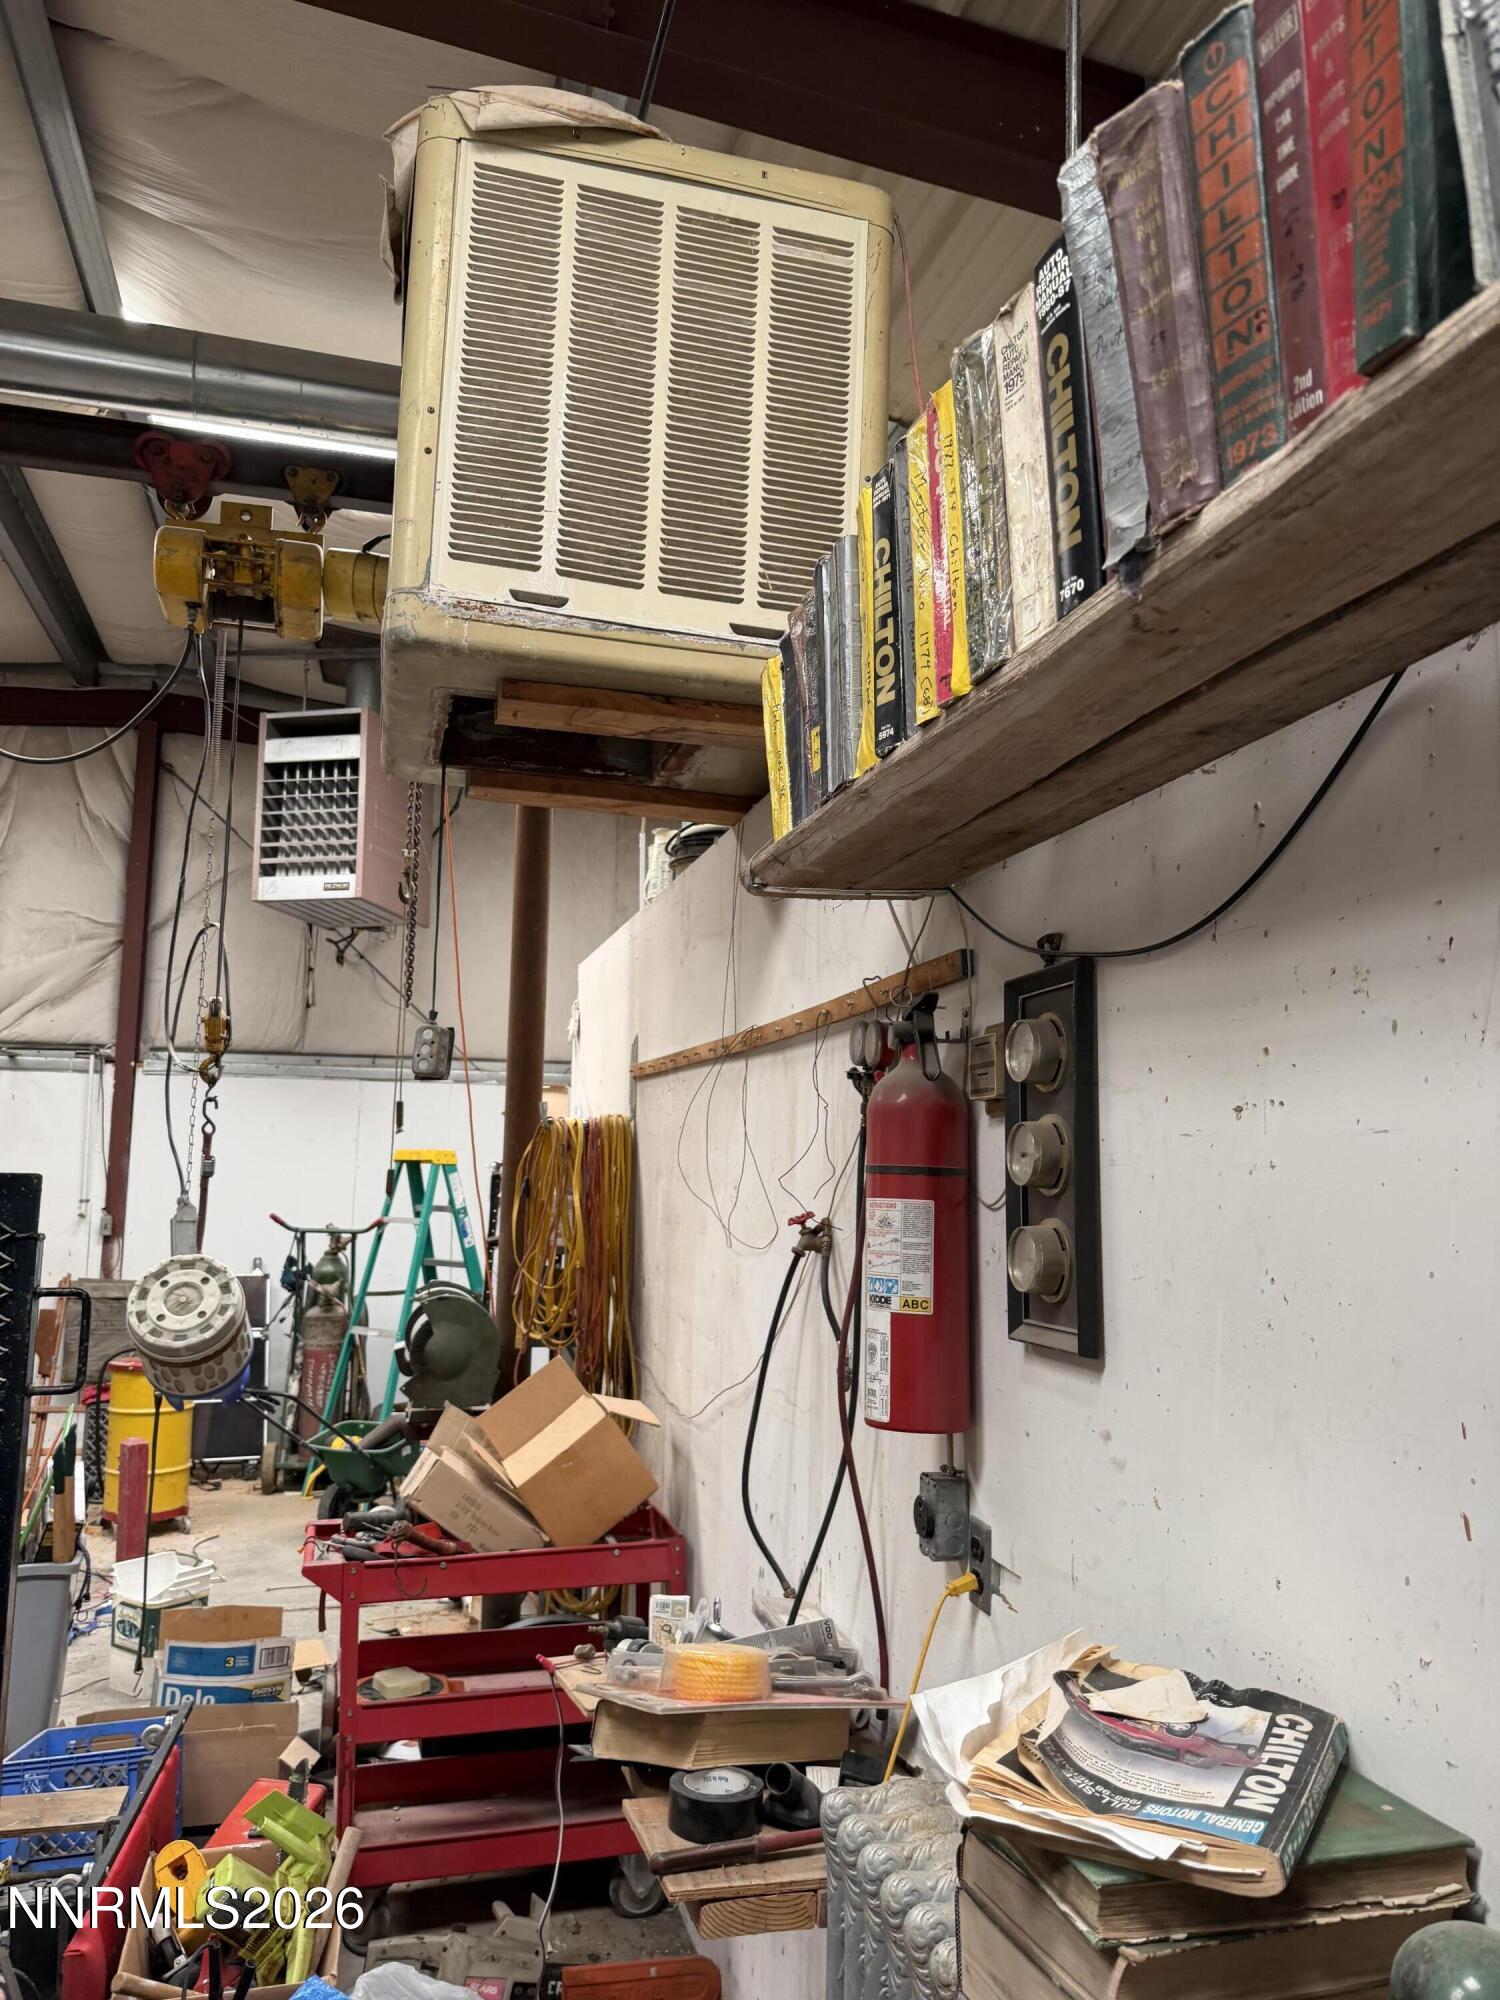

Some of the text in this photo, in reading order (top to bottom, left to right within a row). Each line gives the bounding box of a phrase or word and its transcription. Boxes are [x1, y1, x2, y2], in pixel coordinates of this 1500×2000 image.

[1206, 74, 1252, 358] CHILTON
[1035, 255, 1070, 300] REPAIR
[1037, 247, 1064, 284] AUTO
[1034, 269, 1074, 313] MANUAL
[1037, 279, 1072, 321] 1980-87
[1003, 368, 1026, 395] 1979
[1292, 367, 1314, 395] 2nd
[1287, 388, 1325, 422] Edition
[1045, 332, 1083, 556] CHILTON
[1227, 422, 1278, 471] 1973
[948, 532, 961, 613] Chilton
[1059, 577, 1085, 603] 7670
[873, 537, 897, 707] CHILTON
[878, 726, 895, 742] 5974
[902, 1299, 929, 1310] ABC
[823, 1619, 833, 1640] VDO
[224, 1656, 235, 1668] 3
[164, 1686, 216, 1704] Delo
[1233, 1713, 1313, 1814] CHILTON
[1142, 1804, 1265, 1834] GENERAL MOTORS
